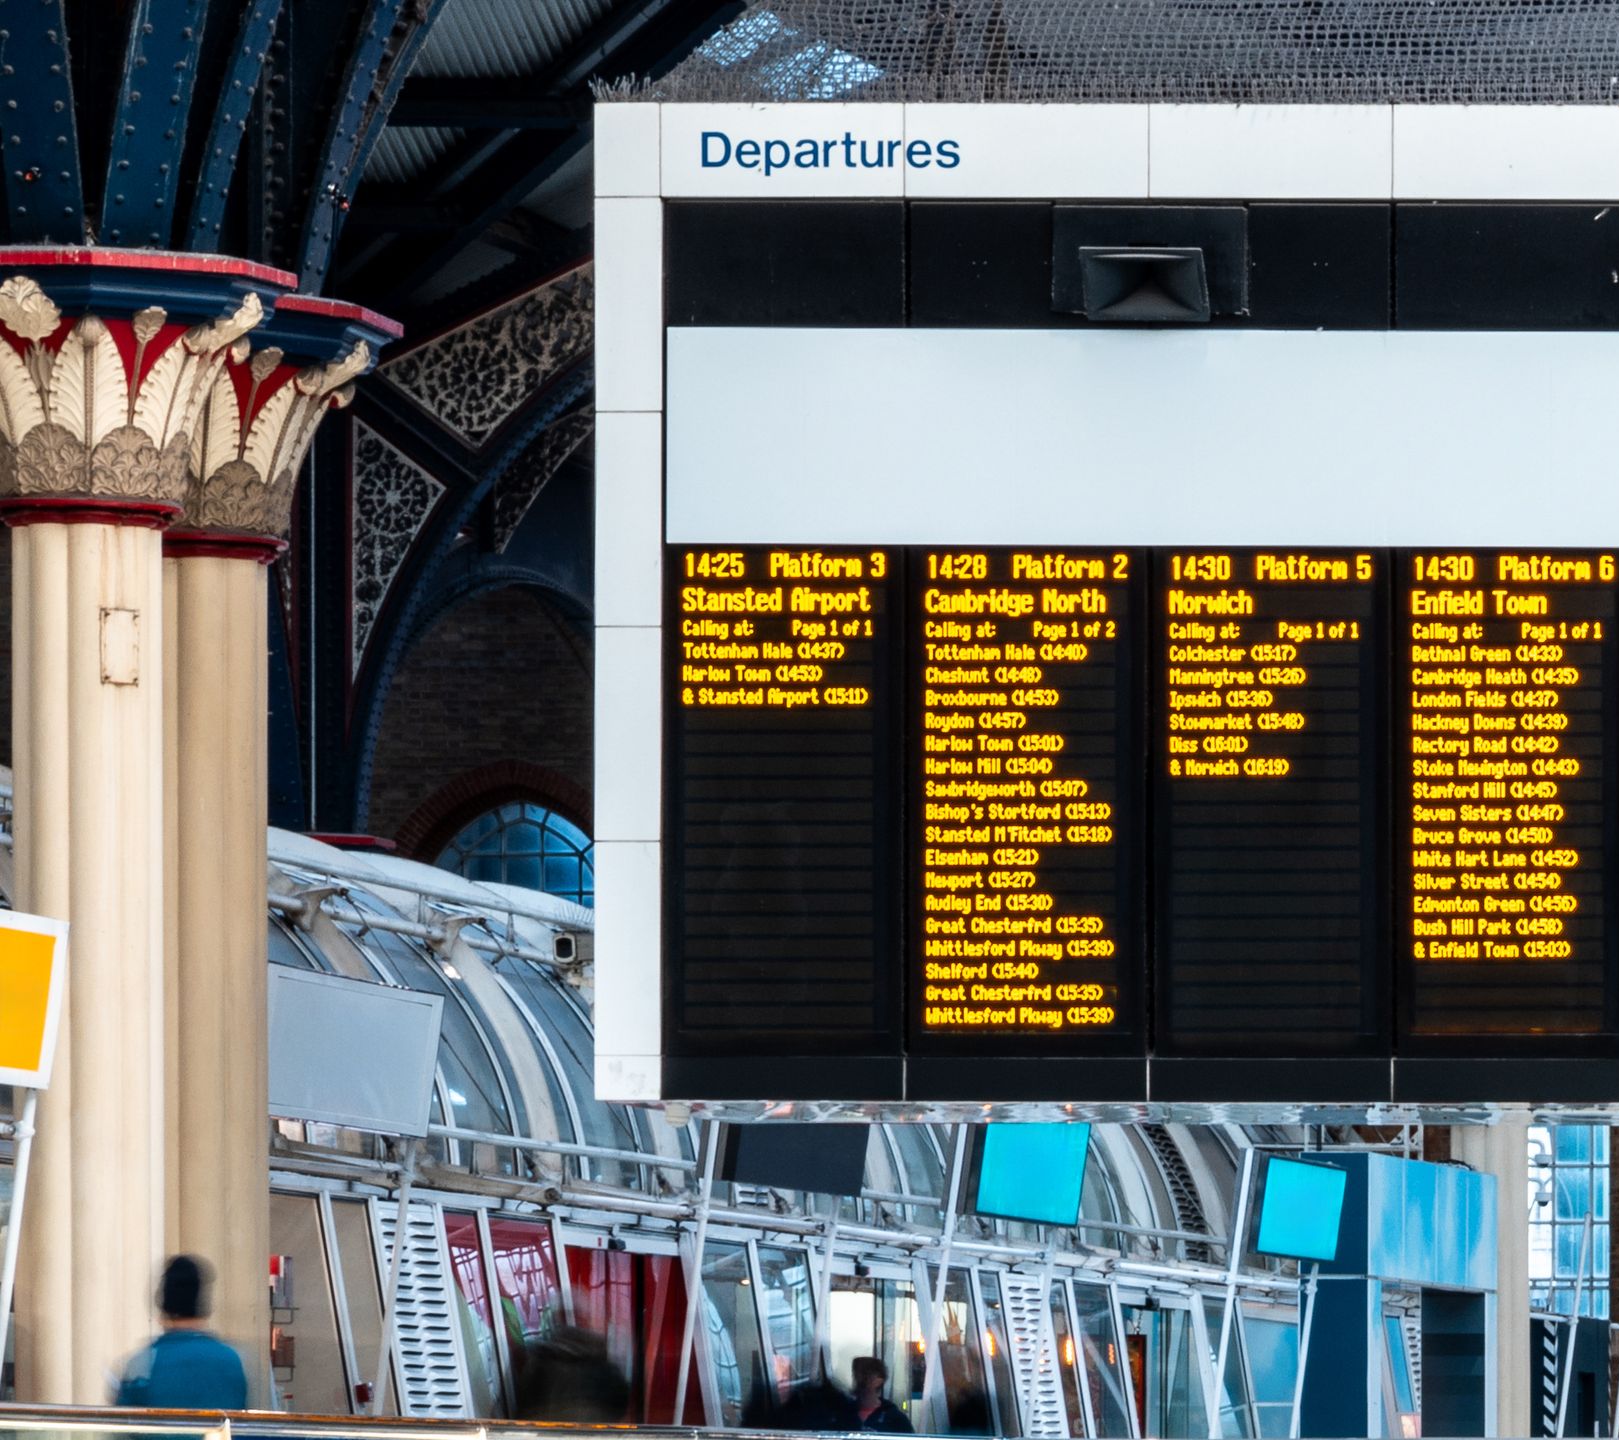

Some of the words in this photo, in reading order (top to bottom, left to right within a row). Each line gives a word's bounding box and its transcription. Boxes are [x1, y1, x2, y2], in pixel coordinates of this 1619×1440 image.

[701, 131, 960, 177] Departures
[685, 552, 745, 578] 14:25
[770, 552, 862, 578] Platform
[870, 552, 886, 578] 3
[928, 554, 987, 579] 14:28
[1012, 554, 1105, 579] Platform
[1112, 554, 1128, 579] 2
[1172, 555, 1231, 581] 14:30
[1256, 555, 1348, 581] Platform
[1356, 554, 1372, 580] 5
[1414, 555, 1474, 581] 14:30
[1499, 555, 1591, 581] Platform
[1599, 555, 1615, 581] 6
[682, 586, 783, 612] Stansted
[790, 586, 872, 616] Airport
[924, 588, 1034, 617] Cambridge
[1042, 588, 1107, 614] North
[1168, 589, 1253, 615] Norwich
[1411, 590, 1484, 615] Enfield
[1491, 589, 1548, 615] Town
[682, 641, 759, 659] Tottenham
[762, 642, 793, 659] Hale
